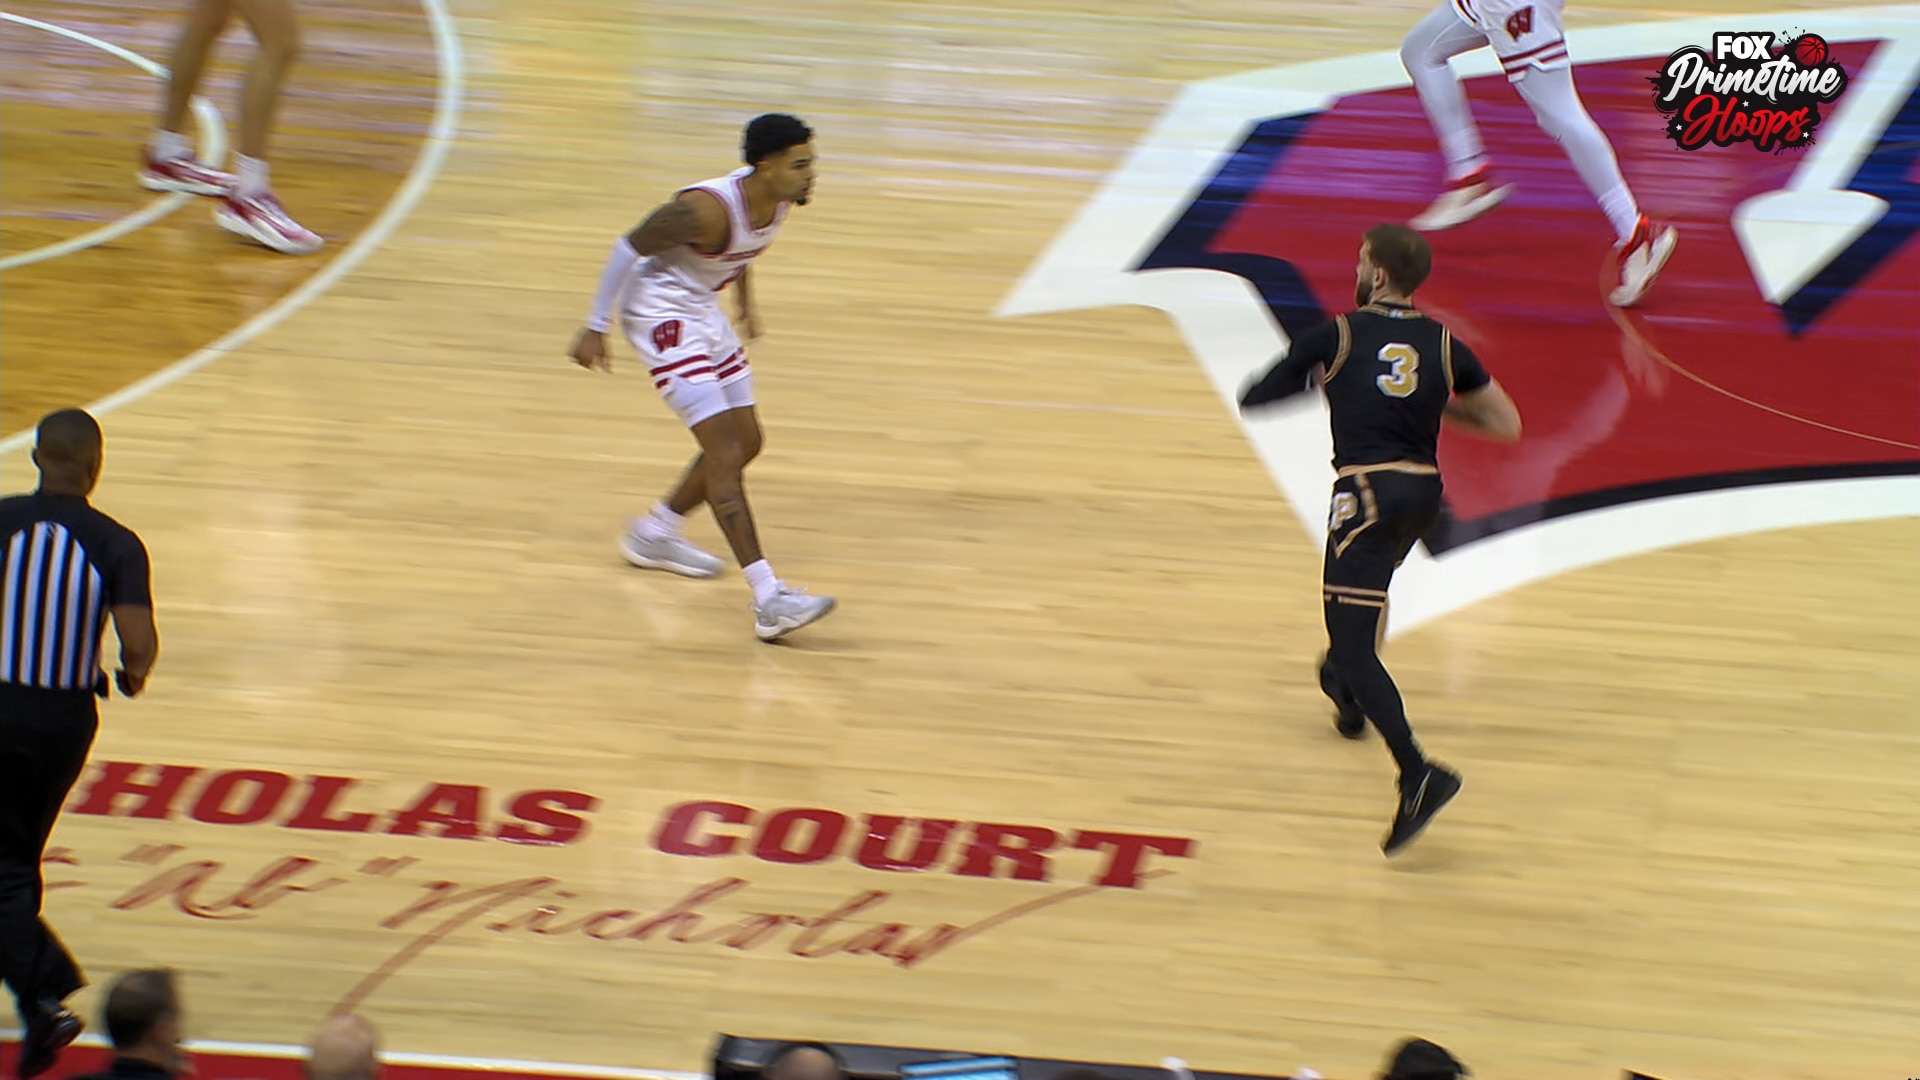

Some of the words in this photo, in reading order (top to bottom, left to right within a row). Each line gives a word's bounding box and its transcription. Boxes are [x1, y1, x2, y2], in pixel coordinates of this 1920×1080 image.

[1376, 342, 1420, 399] 3
[1330, 491, 1358, 531] P
[652, 799, 1195, 889] COURT
